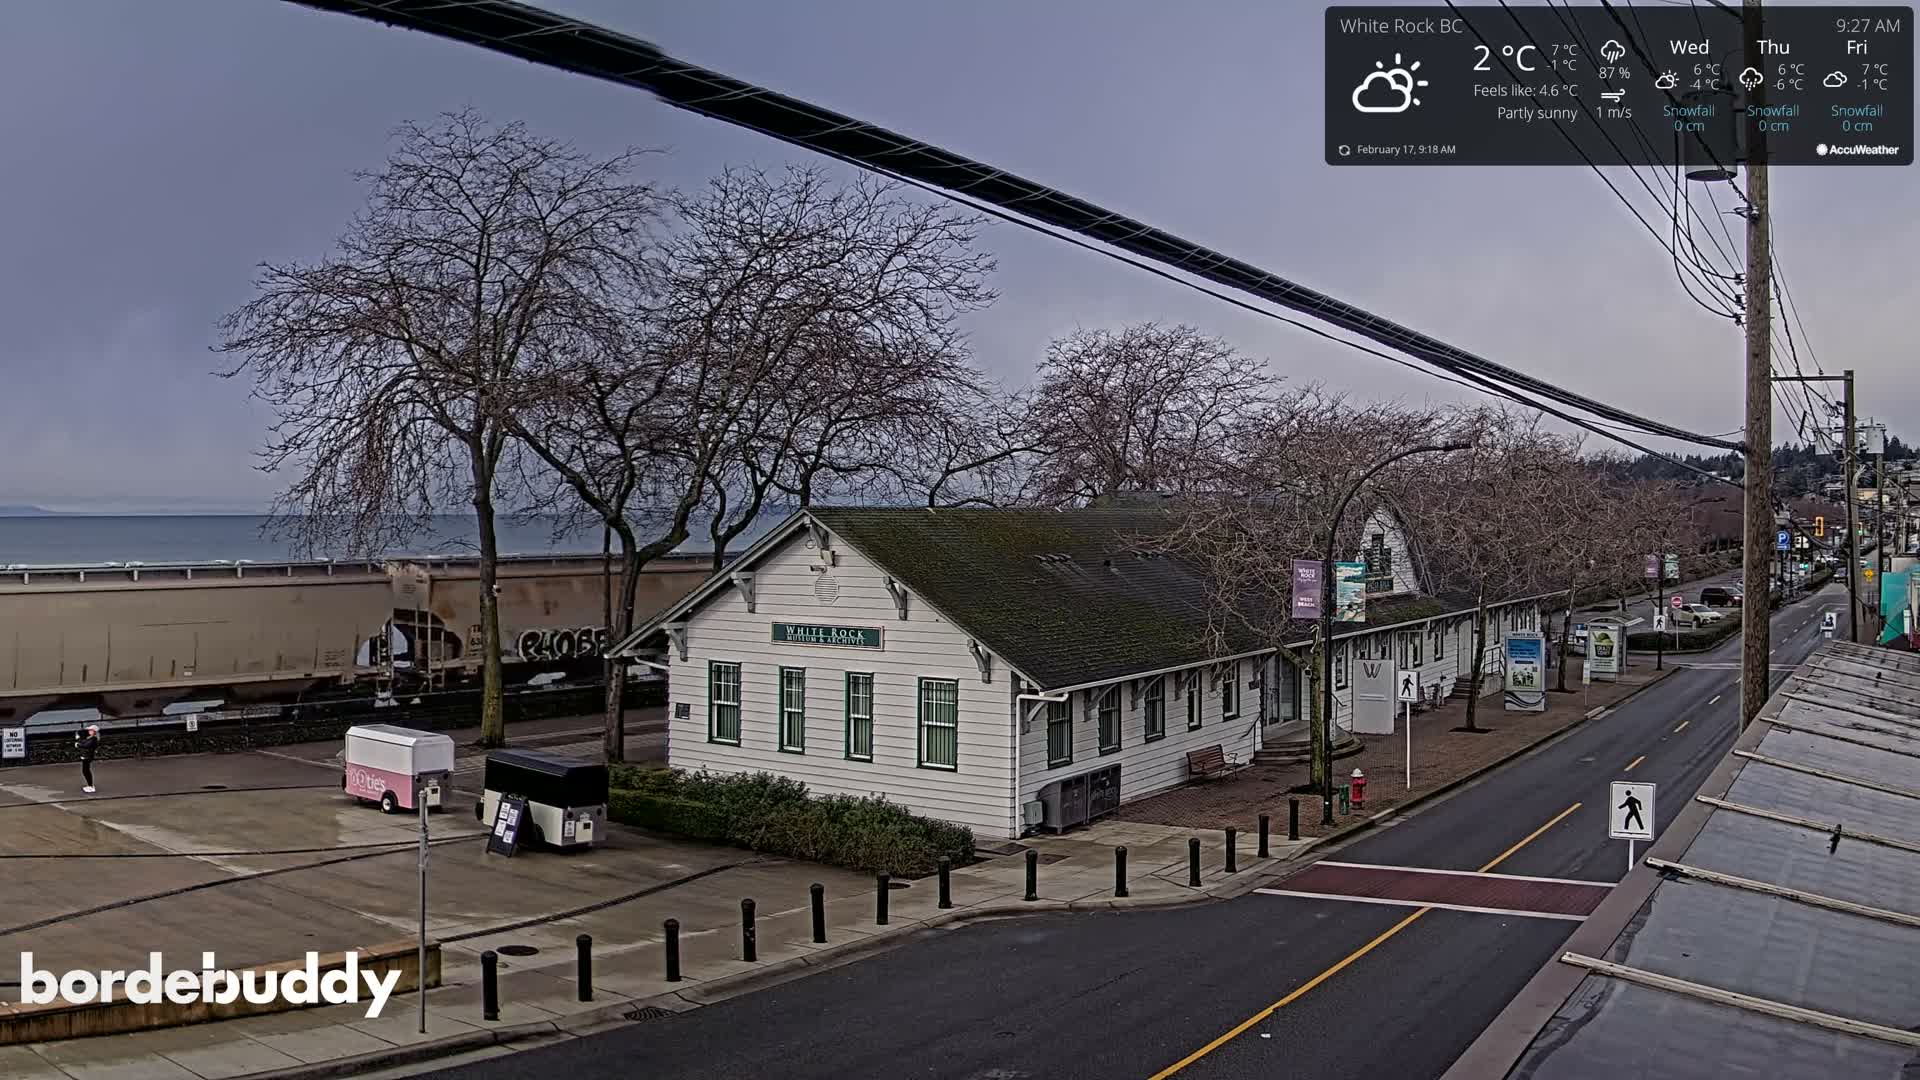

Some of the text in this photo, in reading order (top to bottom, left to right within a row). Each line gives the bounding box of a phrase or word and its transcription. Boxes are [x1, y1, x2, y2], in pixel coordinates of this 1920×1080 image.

[786, 625, 864, 639] WHITE ROCK
[827, 637, 865, 645] ARCHIVES
